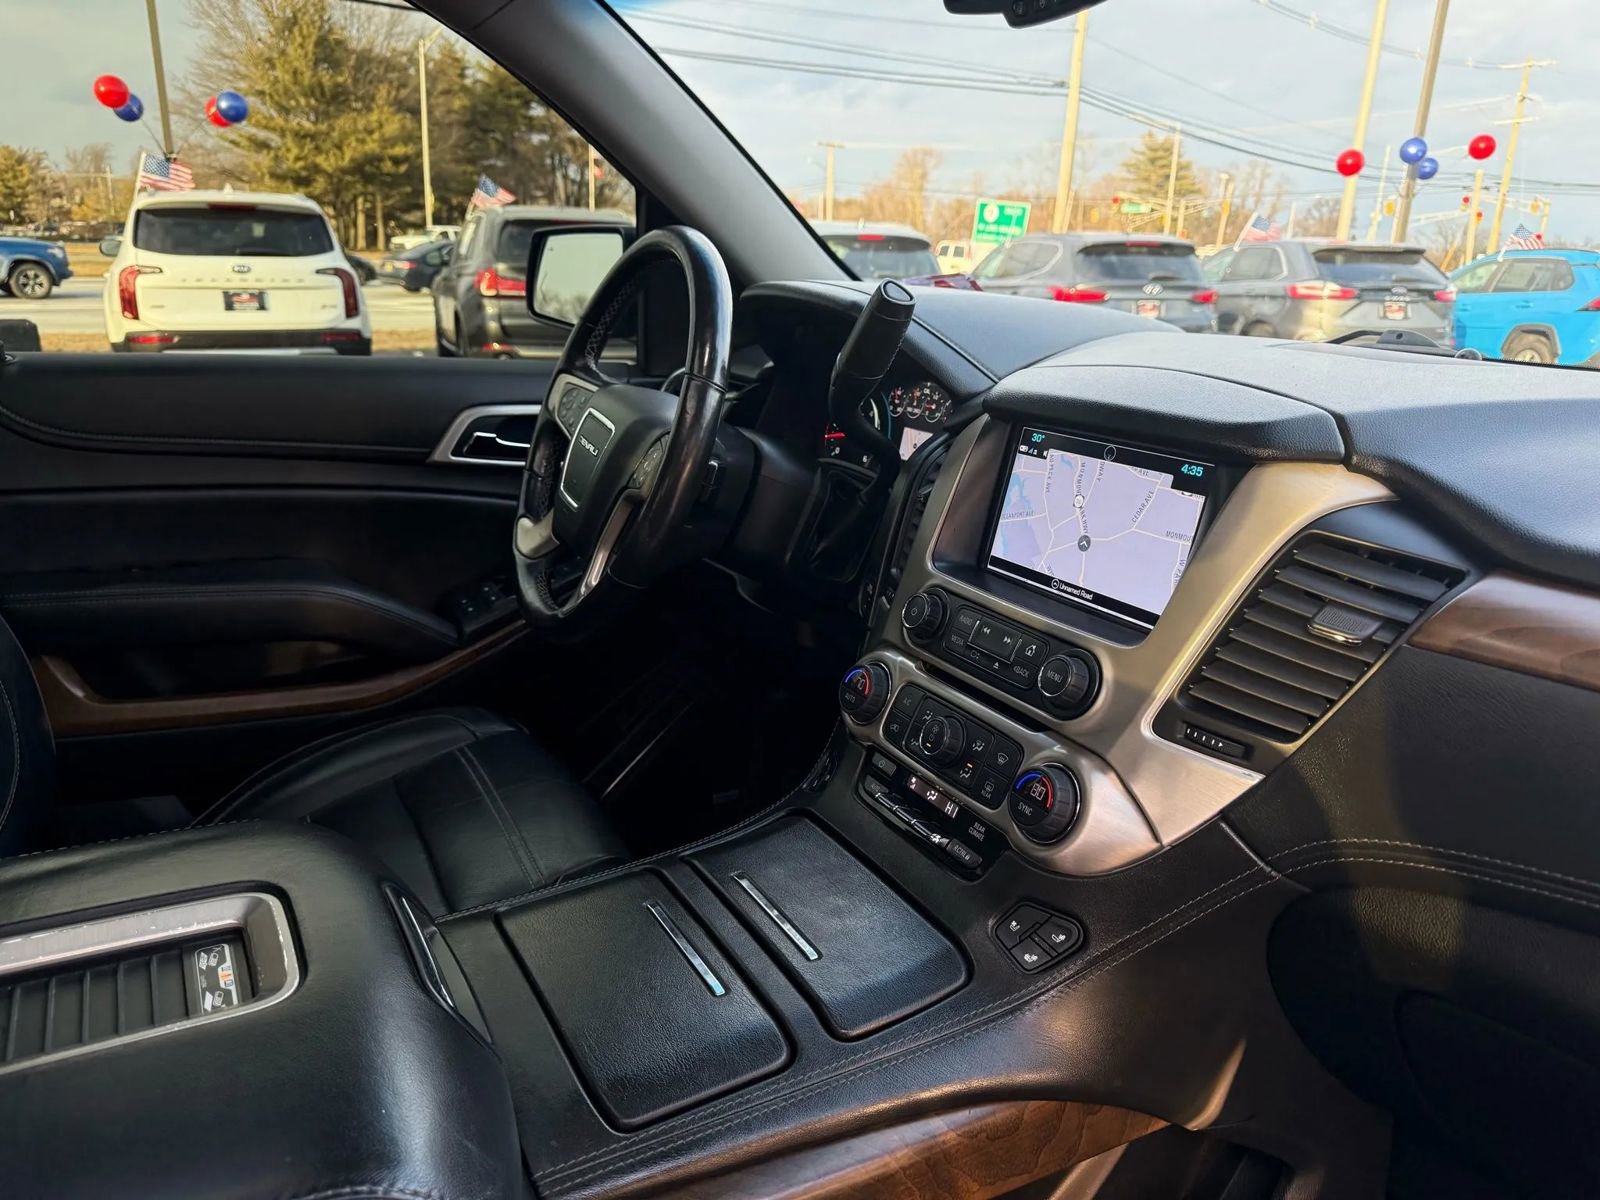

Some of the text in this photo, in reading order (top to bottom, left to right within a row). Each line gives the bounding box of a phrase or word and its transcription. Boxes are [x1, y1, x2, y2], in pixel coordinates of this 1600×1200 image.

[1181, 464, 1204, 477] 4:35
[1131, 491, 1154, 523] CEDAR AVE
[1166, 530, 1193, 542] MONMOU
[1060, 582, 1094, 600] Unnamed Road
[1046, 670, 1063, 683] MENU
[944, 801, 959, 819] HI
[1018, 802, 1033, 816] SYNC
[968, 827, 985, 842] CLIMATE
[973, 822, 986, 833] REAR
